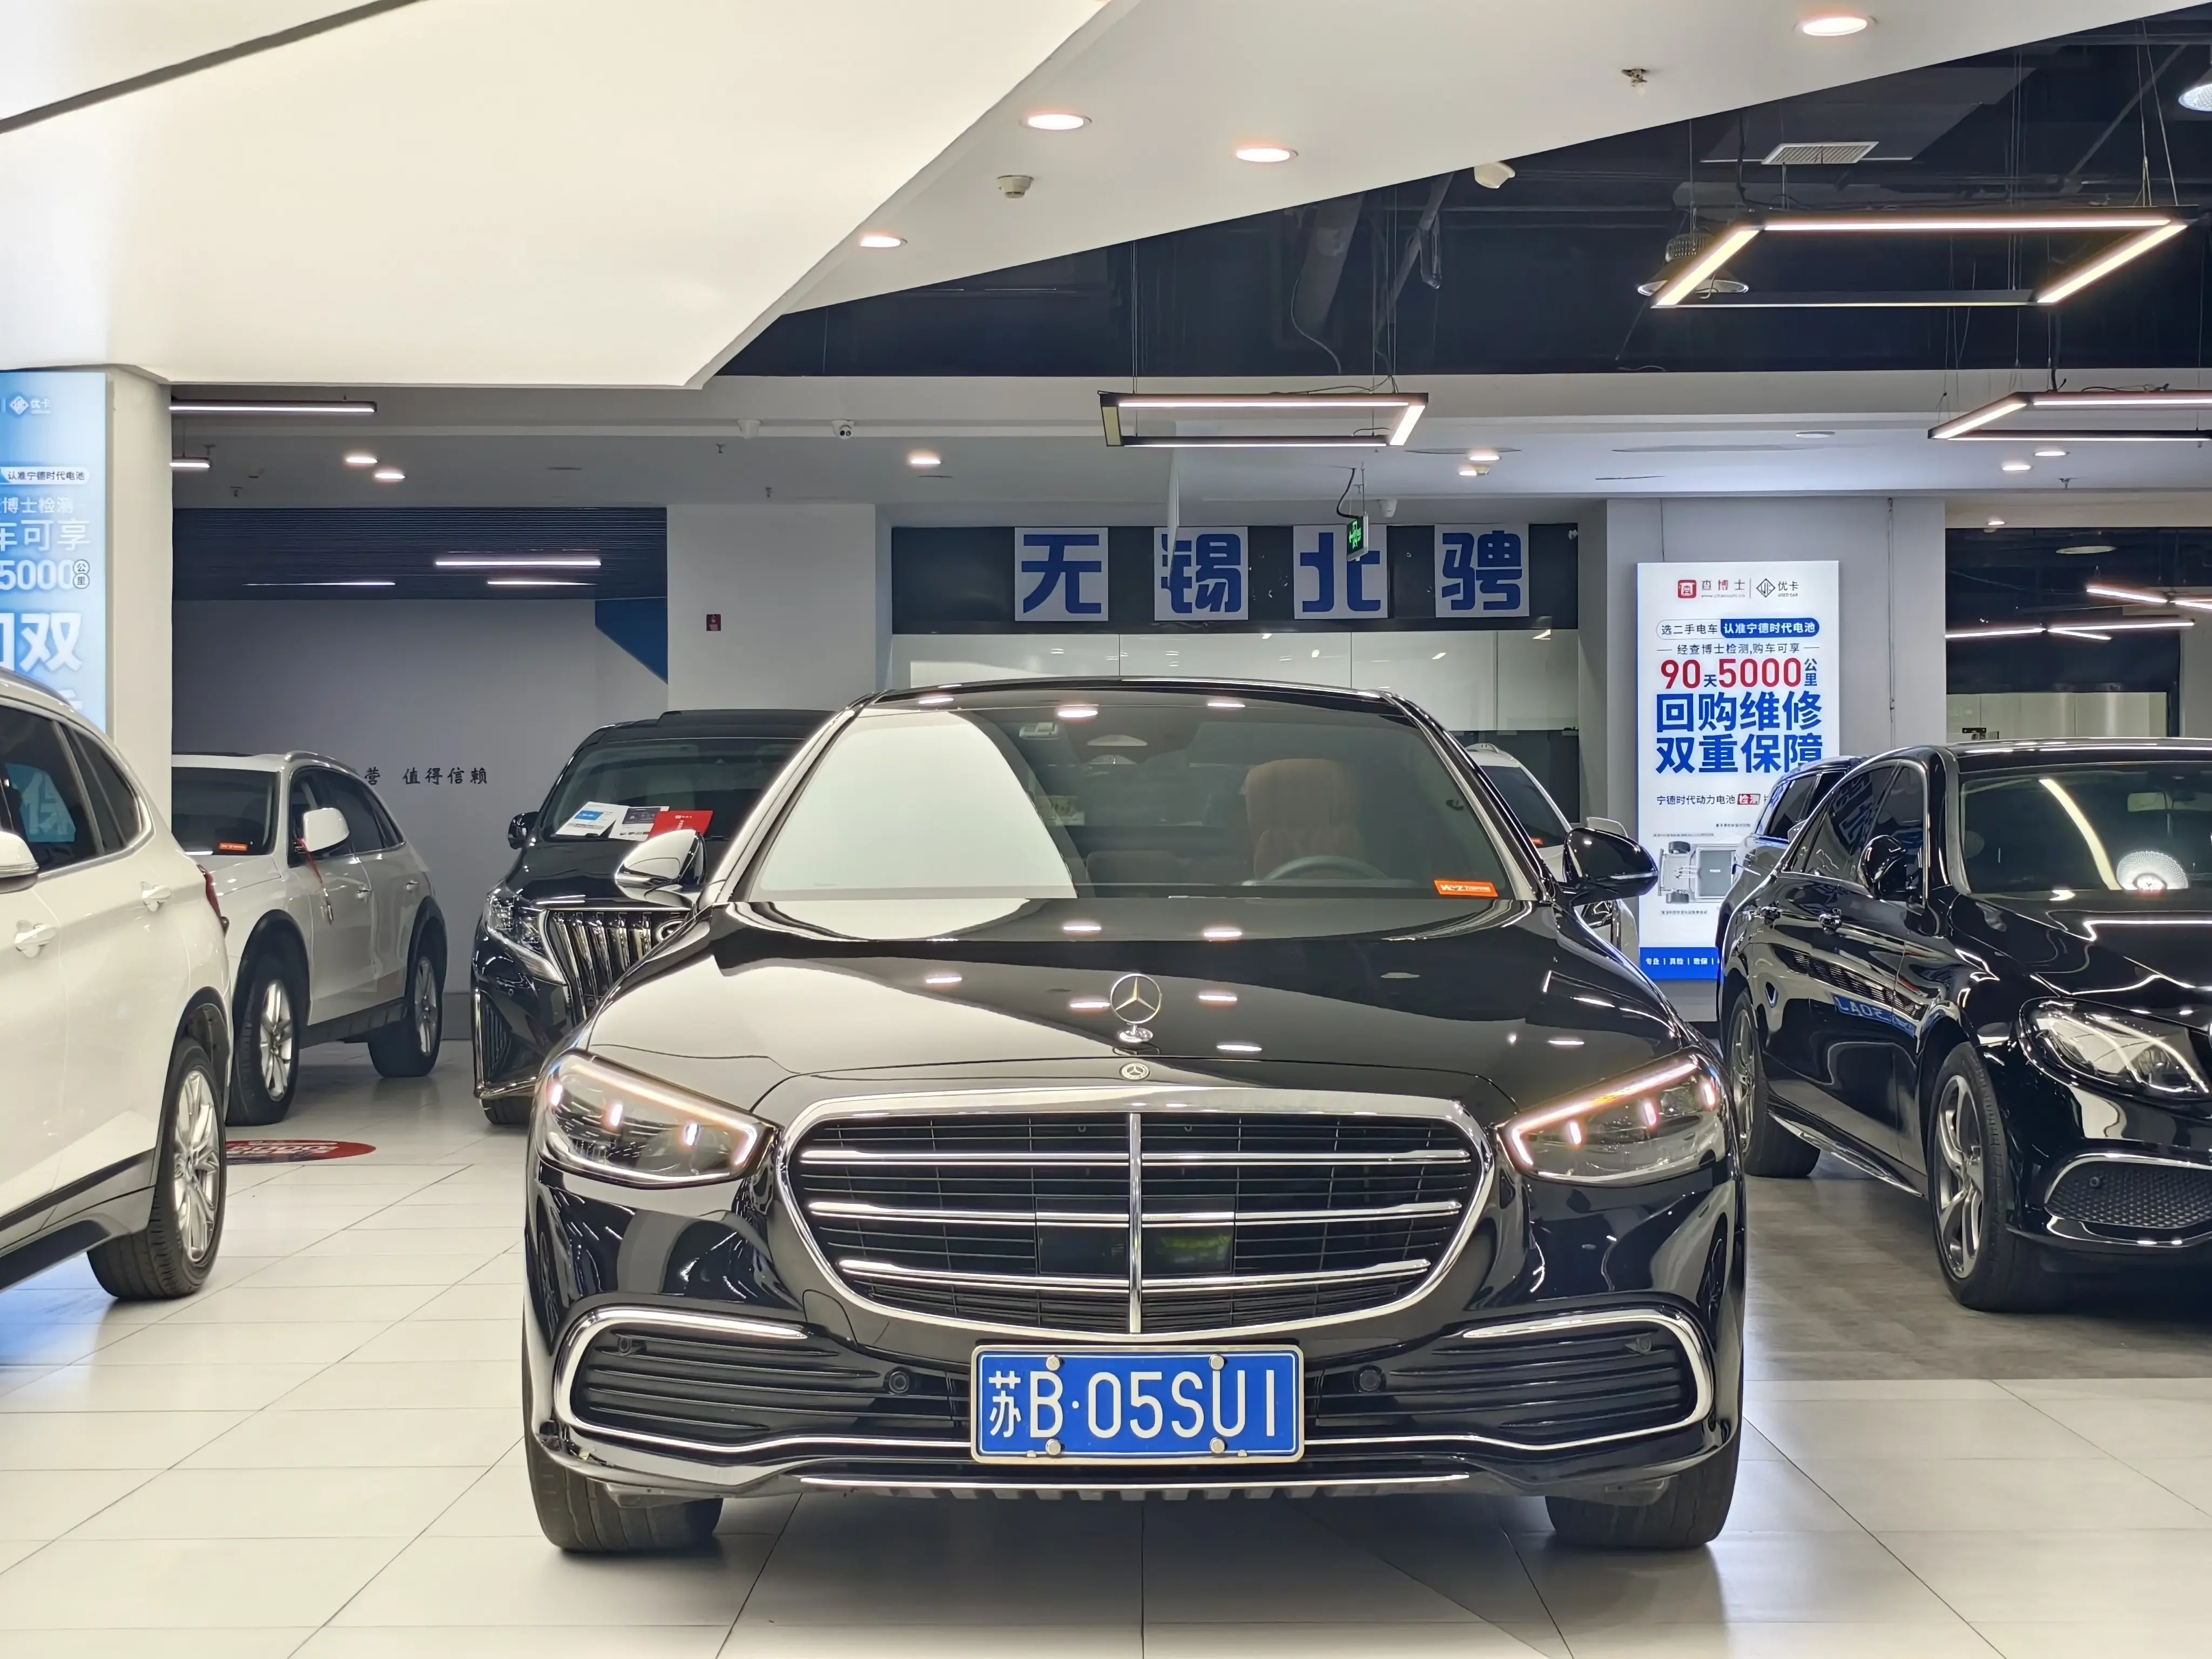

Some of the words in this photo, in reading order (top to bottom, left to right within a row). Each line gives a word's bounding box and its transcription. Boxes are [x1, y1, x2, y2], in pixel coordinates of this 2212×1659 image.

[8, 471, 85, 481] 认准宁德时代电池
[0, 496, 73, 514] 博士检测
[1778, 581, 1799, 591] 优卡
[1661, 624, 1718, 635] 选二手电车
[1723, 622, 1815, 634] 认准宁德时代电池
[0, 612, 81, 673] 双
[1656, 691, 1823, 732] 回购维修
[1656, 733, 1823, 773] 双重保障
[402, 767, 488, 785] 值得信赖
[1656, 795, 1735, 805] 宁德时代动力电池
